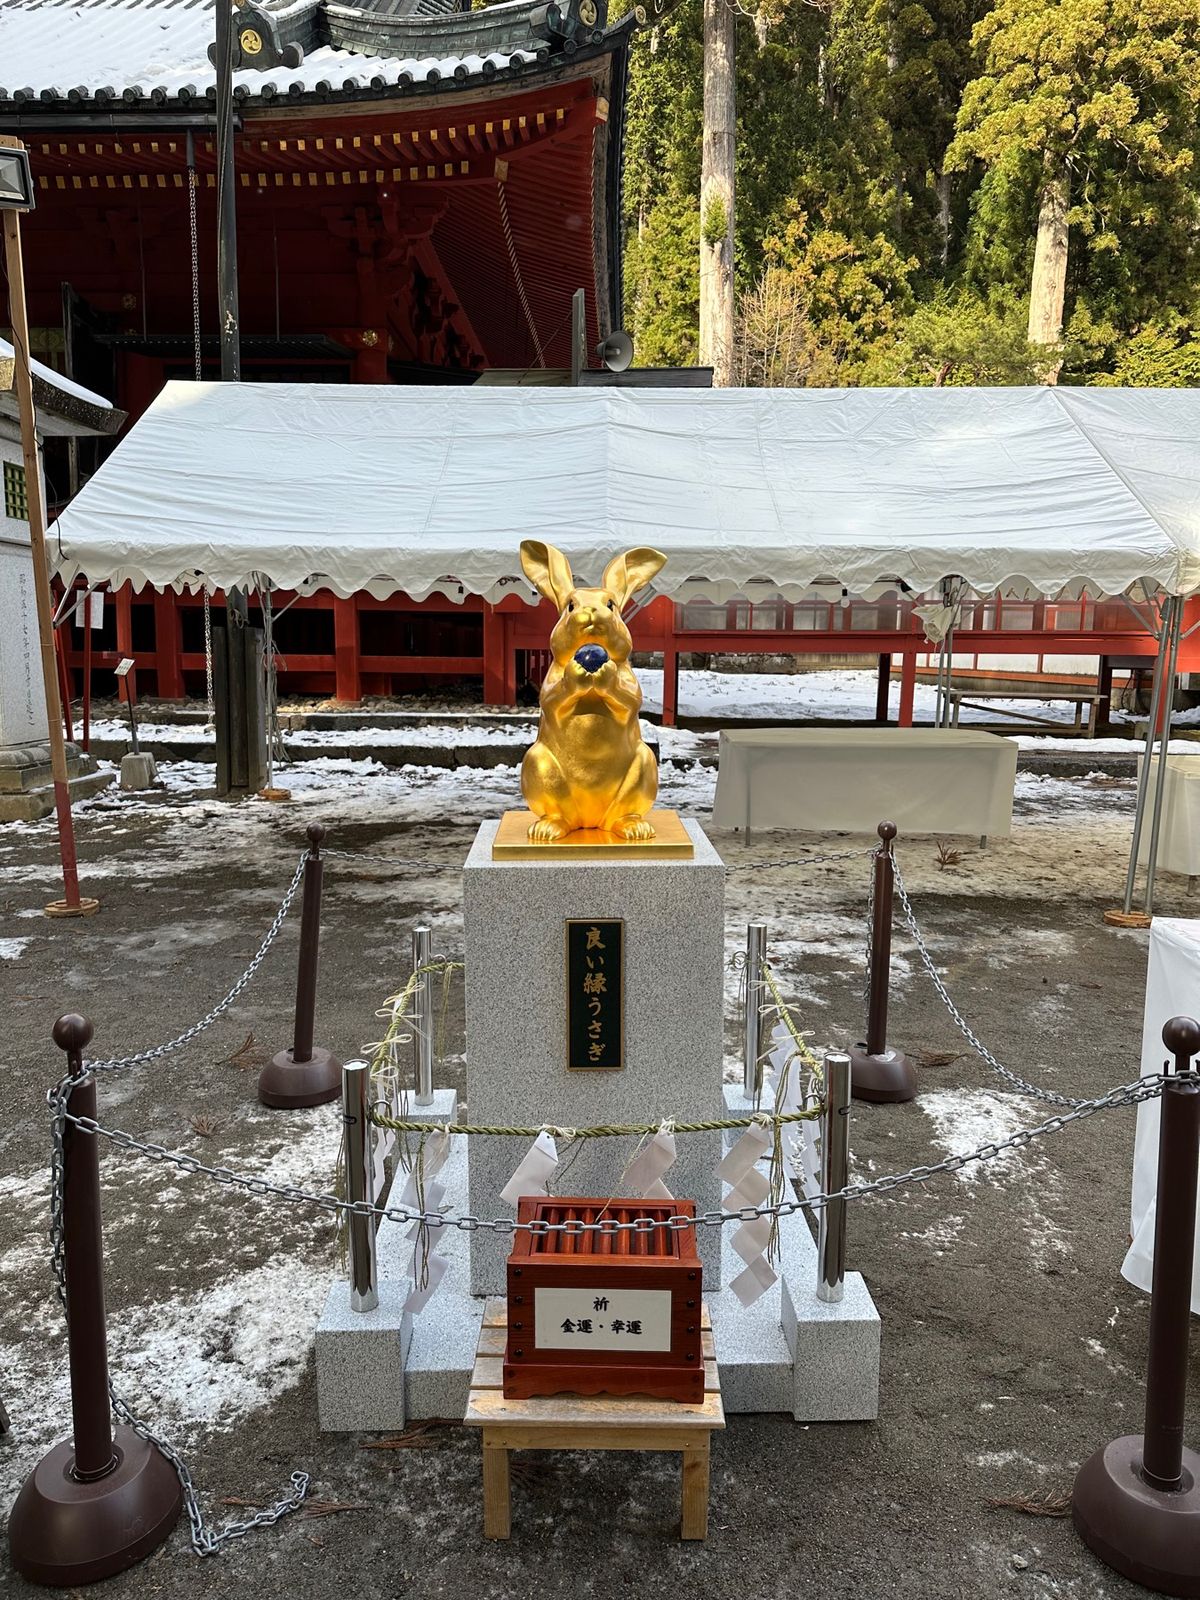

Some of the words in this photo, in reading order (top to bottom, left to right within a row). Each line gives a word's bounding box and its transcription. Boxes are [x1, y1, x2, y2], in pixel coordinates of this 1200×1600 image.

[583, 926, 608, 1062] 良い縁うさぎ
[593, 1296, 610, 1312] 祈
[560, 1318, 643, 1335] 金運・幸運
